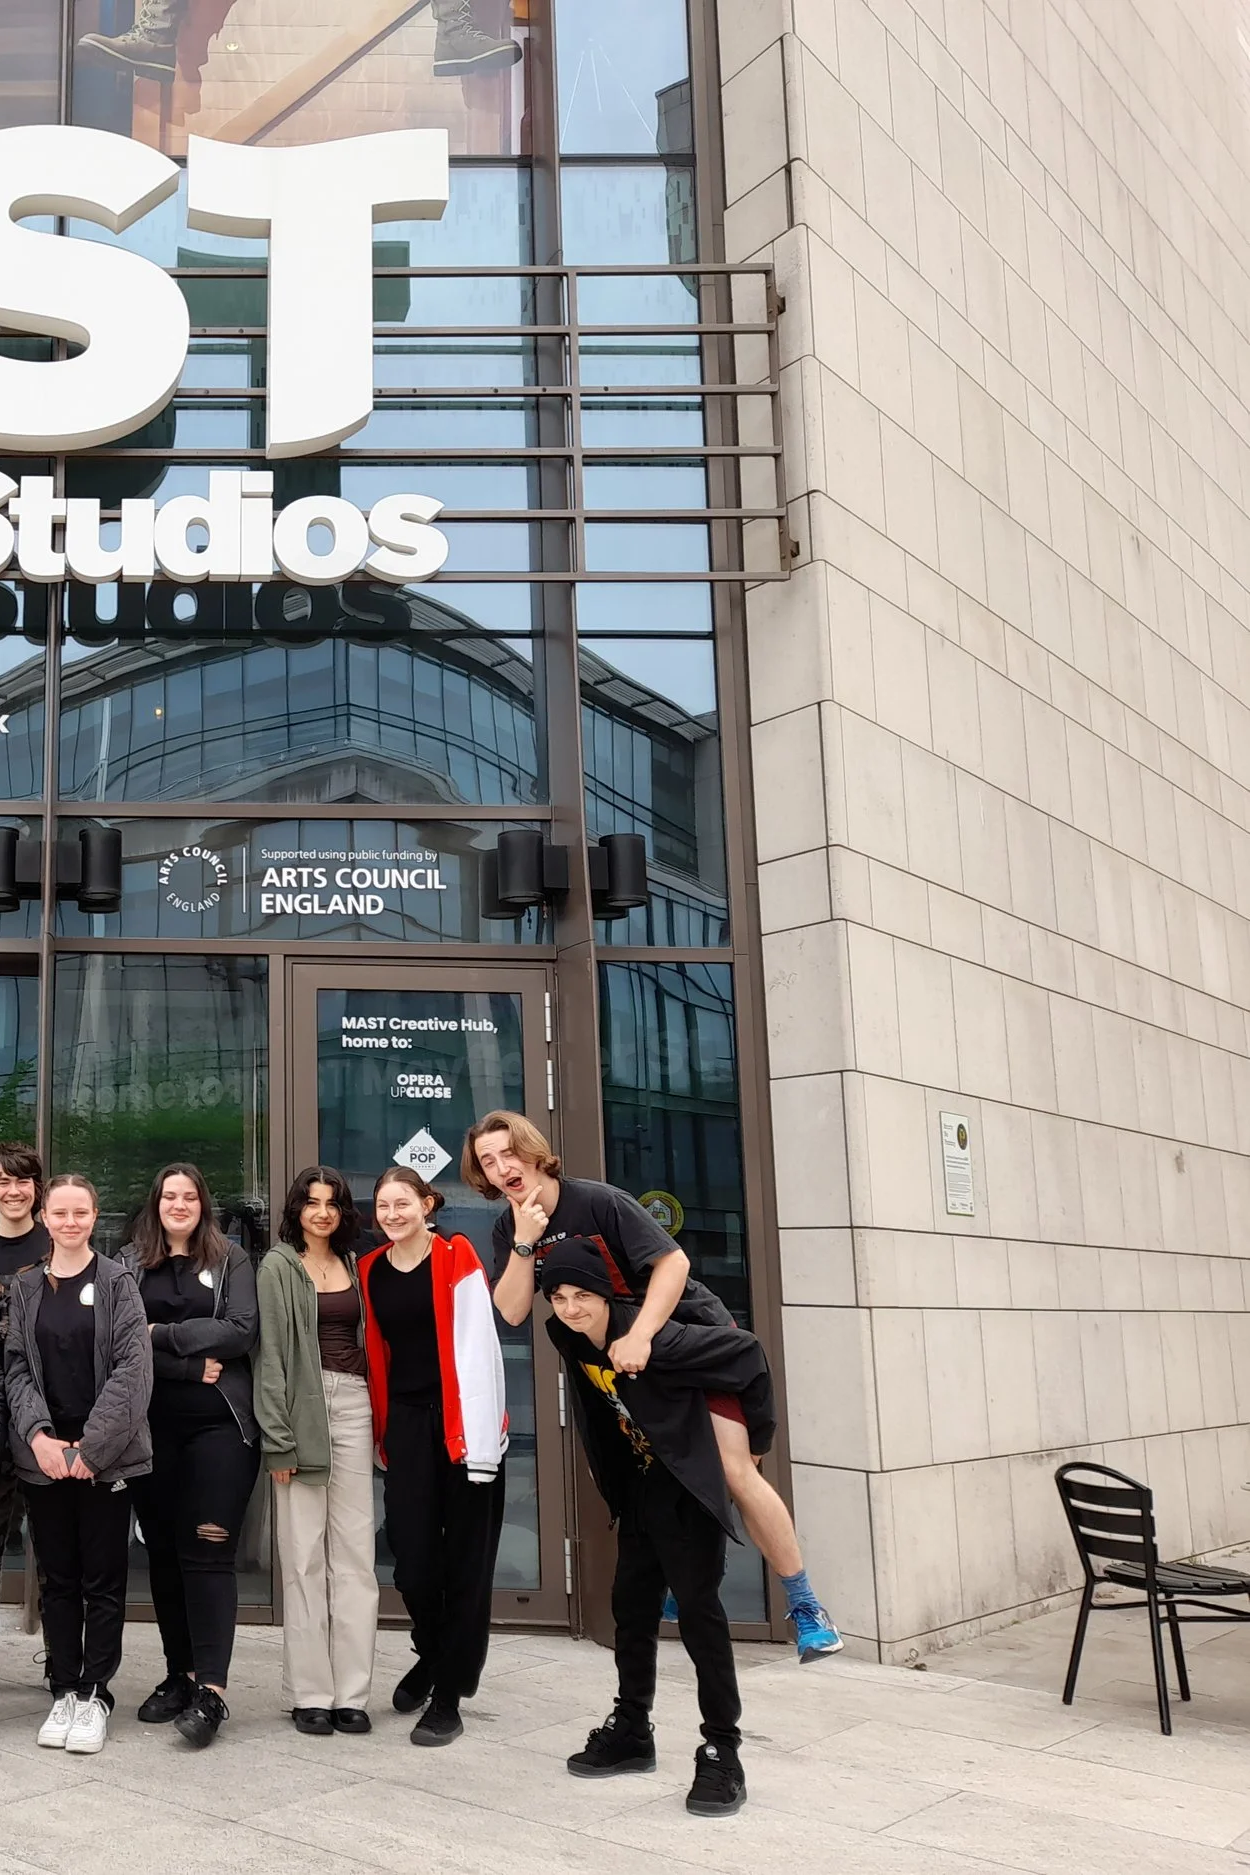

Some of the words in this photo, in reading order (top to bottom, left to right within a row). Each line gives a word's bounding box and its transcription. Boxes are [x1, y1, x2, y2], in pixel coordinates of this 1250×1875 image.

[261, 849, 316, 862] Supported
[318, 851, 346, 862] using
[348, 849, 380, 862] public
[382, 850, 423, 863] funding
[425, 851, 438, 863] by
[158, 854, 180, 886] ARTS
[182, 846, 229, 886] COUNCIL
[261, 868, 327, 889] ARTS
[334, 868, 447, 891] COUNCIL
[166, 892, 221, 913] ENGLAND
[261, 893, 385, 916] ENGLAND
[341, 1017, 386, 1030] MAST
[389, 1017, 458, 1032] Creative
[461, 1019, 498, 1033] Hub,
[342, 1035, 388, 1048] home
[391, 1036, 413, 1049] to:
[396, 1074, 444, 1087] OPERA
[390, 1086, 452, 1099] UPCLOSE
[409, 1153, 436, 1163] POP
